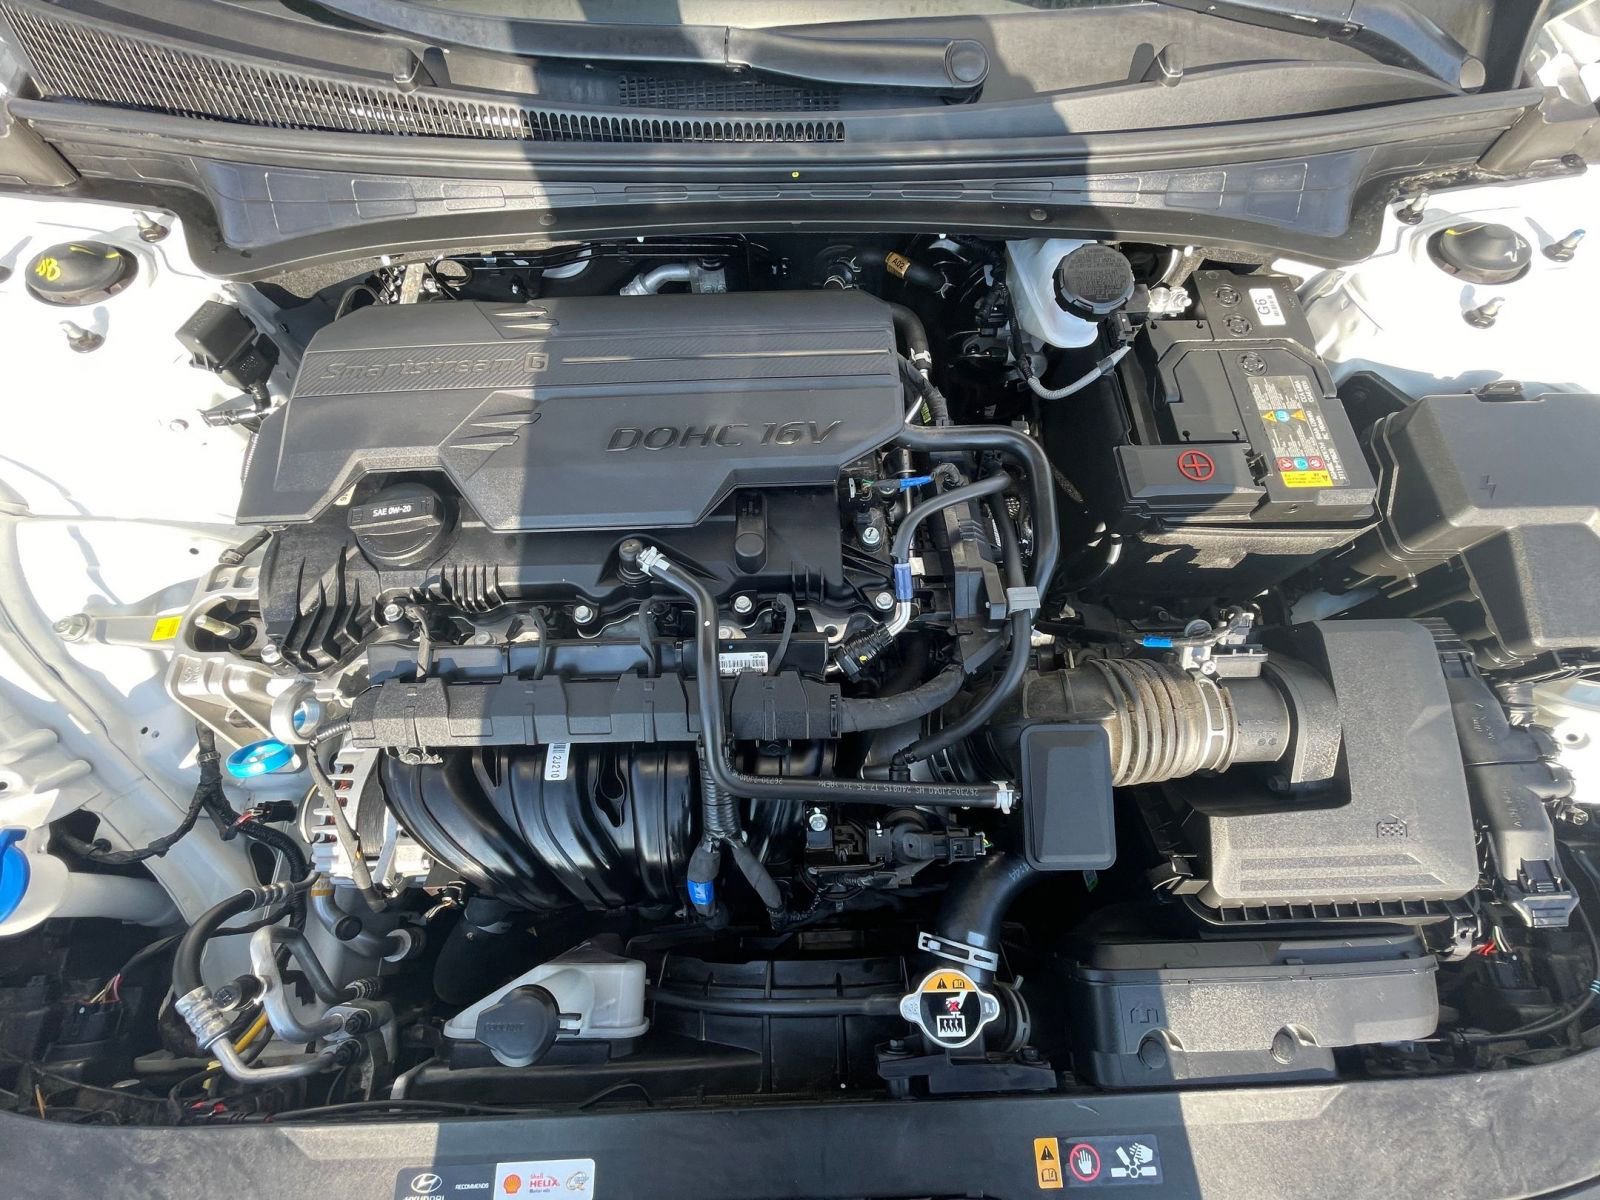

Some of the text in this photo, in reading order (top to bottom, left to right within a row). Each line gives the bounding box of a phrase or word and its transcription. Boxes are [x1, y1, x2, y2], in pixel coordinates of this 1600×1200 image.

[1255, 299, 1271, 315] G6
[320, 358, 516, 379] Smartstream
[604, 420, 843, 452] DOHC 16V
[372, 505, 412, 517] SAE 0W-20
[455, 1182, 489, 1190] RECOMMENDS
[530, 1178, 558, 1188] HELIX
